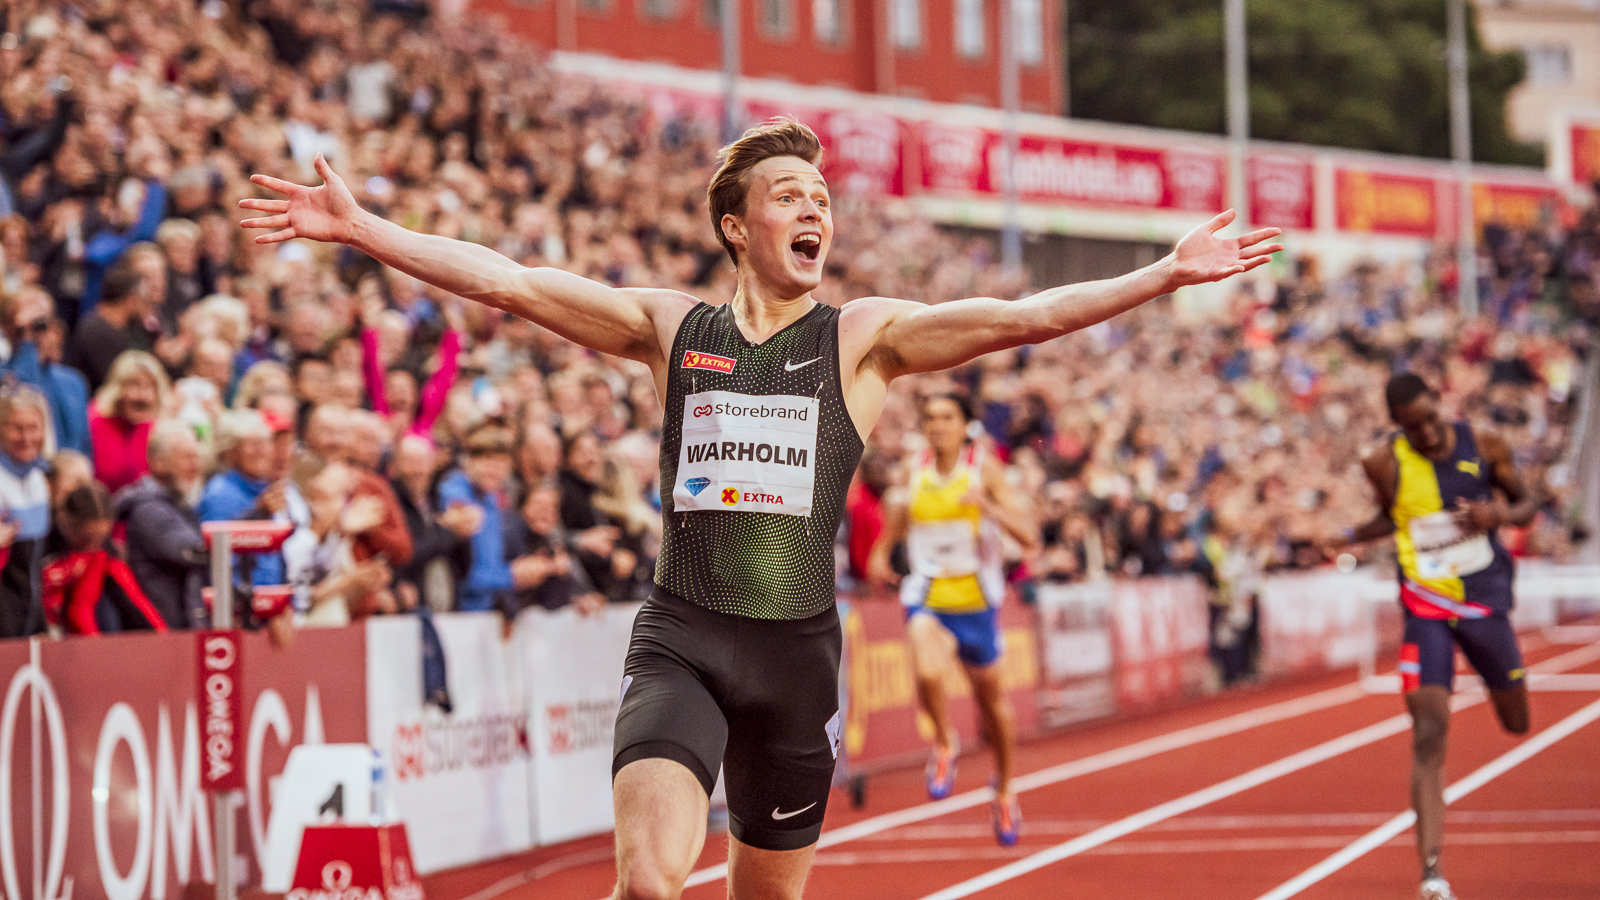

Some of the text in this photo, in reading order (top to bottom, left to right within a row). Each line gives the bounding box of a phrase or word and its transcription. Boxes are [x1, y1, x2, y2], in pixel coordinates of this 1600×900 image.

[700, 357, 731, 370] EXTRA
[715, 402, 808, 421] storebrand
[686, 441, 808, 468] WARHOLM
[743, 492, 784, 505] EXTRA
[206, 672, 234, 781] OMEGA
[94, 682, 326, 900] OMG
